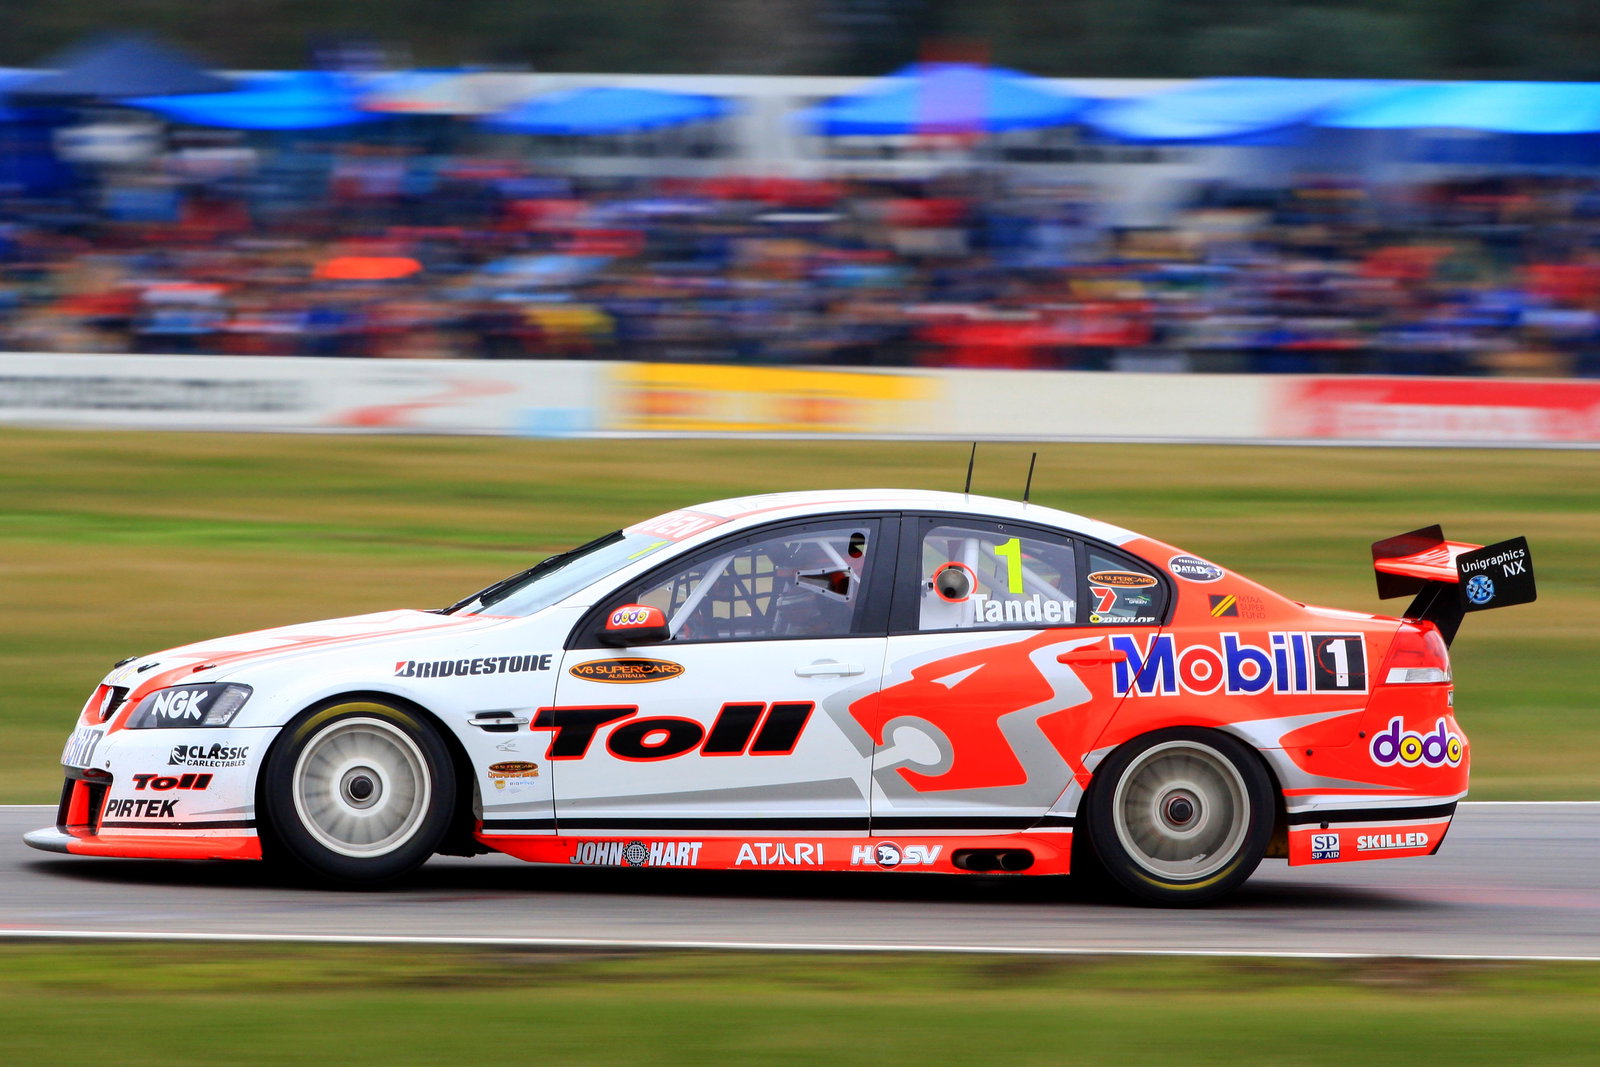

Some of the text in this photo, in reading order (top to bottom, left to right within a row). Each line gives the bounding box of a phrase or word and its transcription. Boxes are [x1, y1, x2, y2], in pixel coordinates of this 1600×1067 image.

[994, 538, 1024, 593] 1
[1462, 549, 1525, 573] Unigraphics
[1503, 560, 1526, 577] NX
[613, 609, 649, 625] dodo
[969, 594, 1074, 622] Tander
[394, 654, 552, 678] BRIDGESTONE
[575, 664, 682, 674] V8 SUPERCARS
[1108, 631, 1308, 698] Mobil
[152, 690, 208, 720] NGK
[529, 700, 816, 762] Toll
[188, 743, 249, 760] CLASSIC
[1369, 715, 1463, 768] dodo
[187, 760, 246, 768] CARLECTABLES
[132, 773, 213, 790] Toll
[104, 799, 180, 817] PIRTEK
[1314, 835, 1337, 849] SP
[1357, 833, 1428, 849] SKILLED
[570, 842, 702, 866] JOHN HART
[735, 843, 823, 866] ATARI
[1311, 851, 1339, 859] SP AIR
